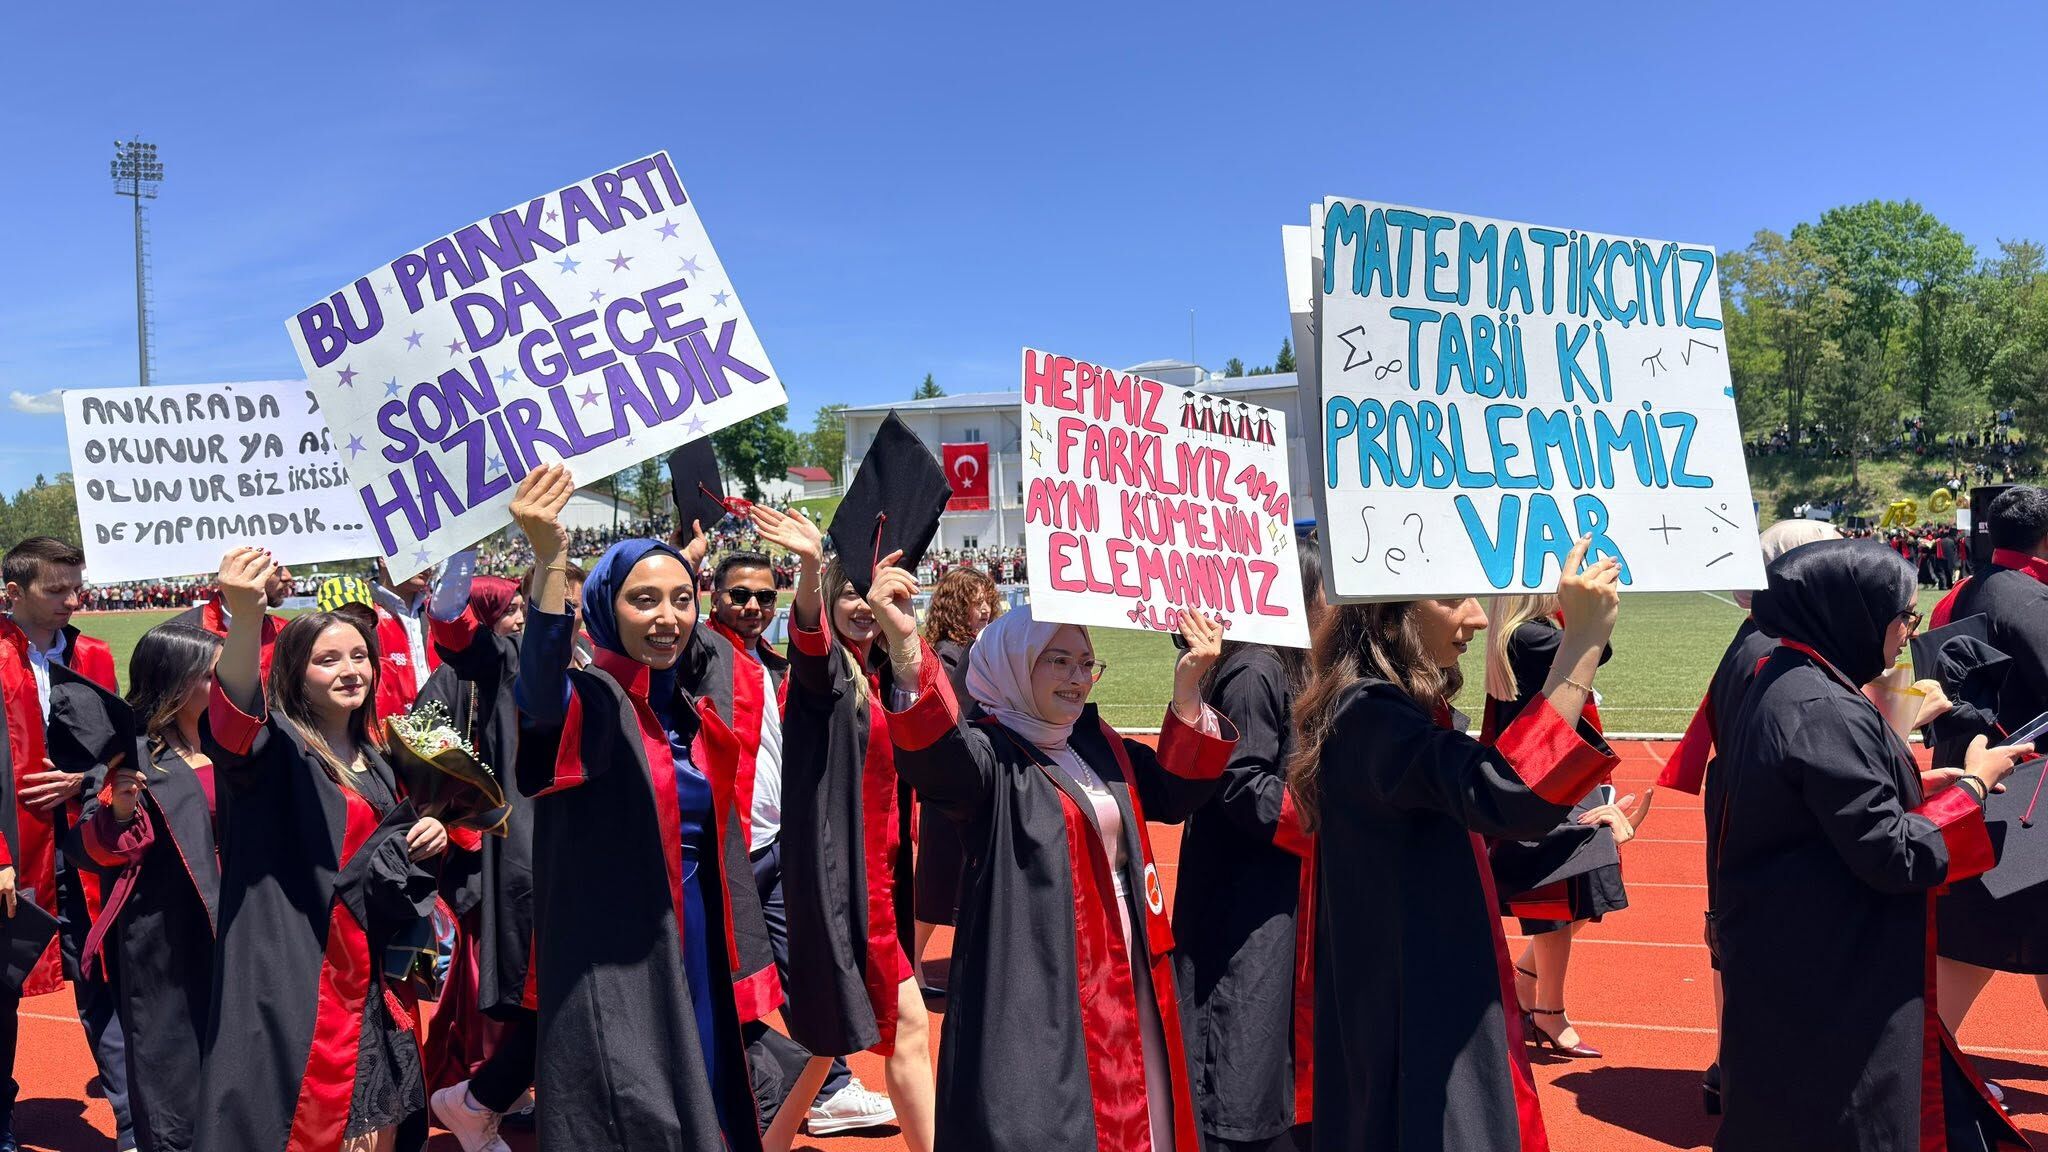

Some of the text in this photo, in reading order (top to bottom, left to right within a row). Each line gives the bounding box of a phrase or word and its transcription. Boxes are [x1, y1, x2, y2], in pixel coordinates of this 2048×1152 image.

[297, 153, 687, 368] BU PANKARTI
[1323, 201, 1723, 331] MATEMATİKÇİYİZ
[450, 270, 562, 353] DA
[1390, 306, 1527, 399] TABİİ
[1556, 319, 1612, 403] Kİ
[377, 278, 707, 464] SON GECE
[1024, 349, 1168, 435] HEPİMİZ
[84, 426, 337, 464] OKUNUR YA AŞ
[360, 318, 770, 557] HAZIRLADIK
[1057, 416, 1288, 526] FARKLIYIZ AMA
[1325, 395, 1713, 490] PROBLEMİMİZ
[87, 474, 235, 503] OLUNUR
[238, 469, 285, 497] BİZ
[1025, 477, 1262, 556] AYNI KÜMENİN
[1048, 531, 1288, 617] ELEMANIYIZ
[1454, 493, 1633, 589] VAR
